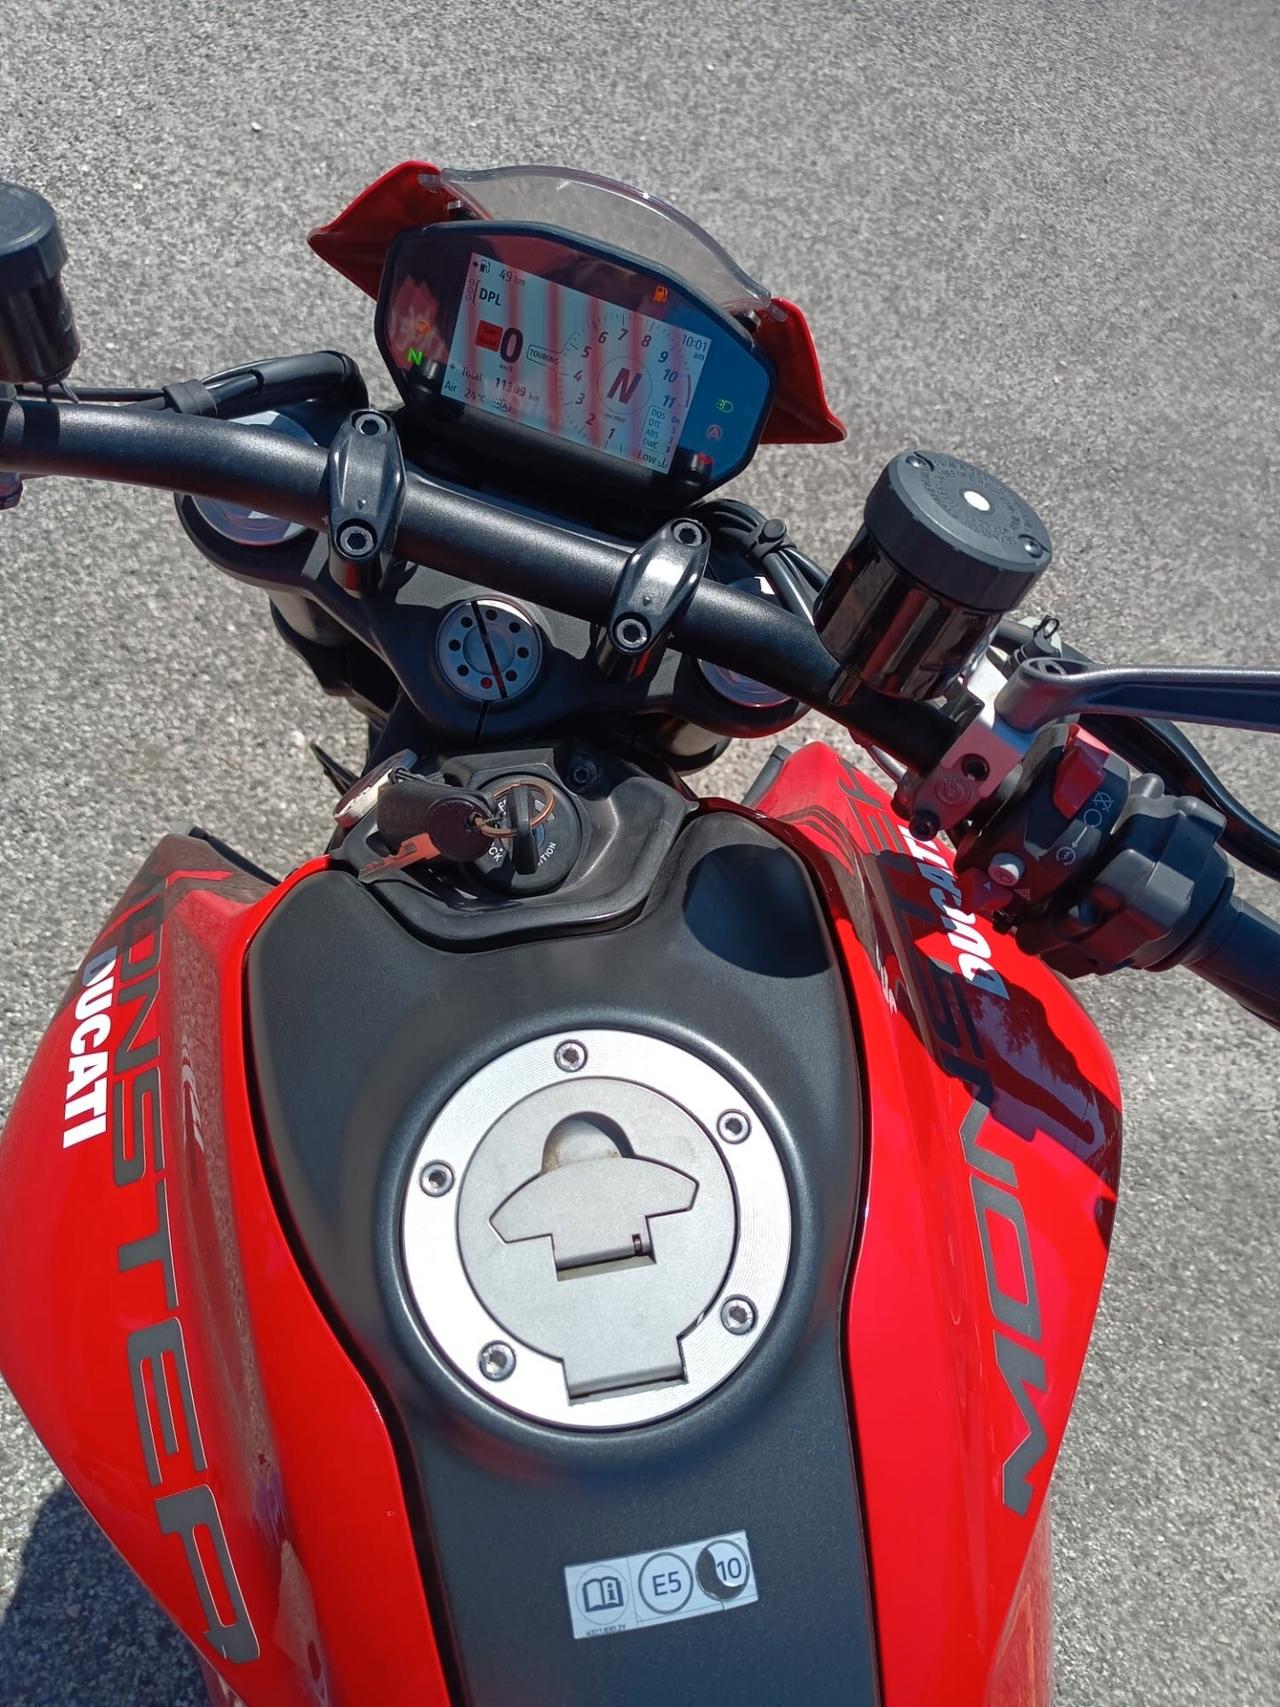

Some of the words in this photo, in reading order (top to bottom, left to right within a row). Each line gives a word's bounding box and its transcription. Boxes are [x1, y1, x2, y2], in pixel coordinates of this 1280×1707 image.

[499, 269, 512, 282] 49
[513, 274, 526, 287] km
[479, 288, 502, 306] DPL
[598, 332, 608, 343] 6
[618, 328, 628, 341] 7
[641, 335, 652, 347] 8
[500, 327, 523, 363] 0
[681, 334, 708, 353] 10:01
[408, 349, 422, 365] N
[530, 349, 559, 365] TOURING
[581, 346, 592, 358] 5
[658, 351, 669, 363] 9
[461, 367, 483, 382] Total
[573, 370, 583, 382] 4
[663, 368, 678, 383] 10
[444, 380, 457, 392] Air
[607, 367, 643, 404] N
[575, 393, 585, 405] 3
[663, 395, 676, 409] 11
[585, 413, 596, 426] 2
[607, 428, 616, 440] 1
[646, 429, 659, 439] ABS
[63, 946, 119, 1149] DUCATI
[716, 1557, 742, 1581] 10
[652, 1571, 682, 1597] E5
